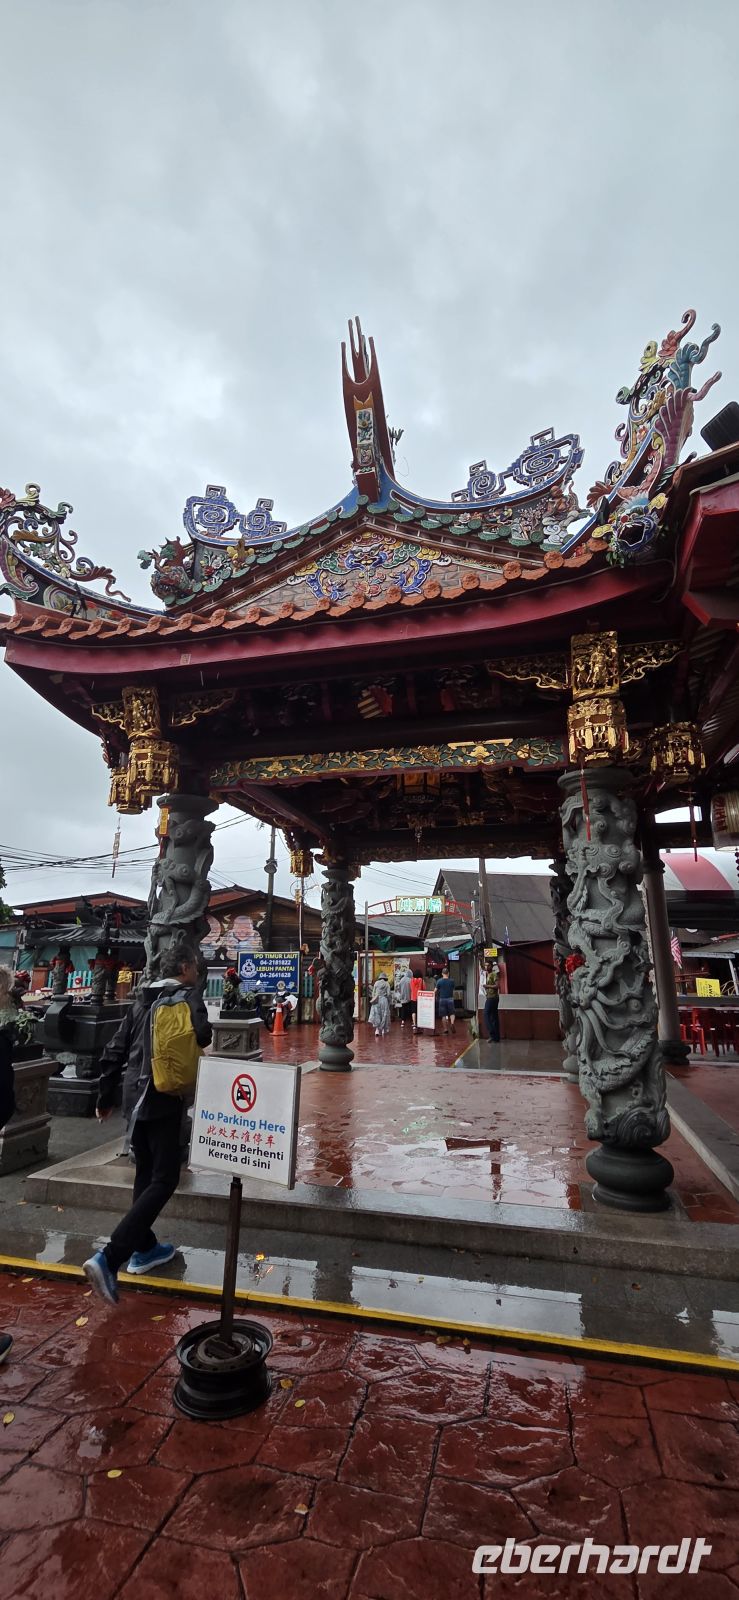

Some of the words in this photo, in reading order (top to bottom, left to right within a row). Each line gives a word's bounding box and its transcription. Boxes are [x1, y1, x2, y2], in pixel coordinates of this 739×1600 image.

[200, 1109, 215, 1121] No
[217, 1112, 257, 1131] Parking
[258, 1119, 286, 1134] Here
[198, 1135, 238, 1153] Dilarang
[240, 1143, 284, 1161] Berhenti
[207, 1124, 276, 1148] 此处不准停车
[208, 1148, 238, 1163] Kereta
[240, 1155, 250, 1166] di
[252, 1159, 271, 1170] sini
